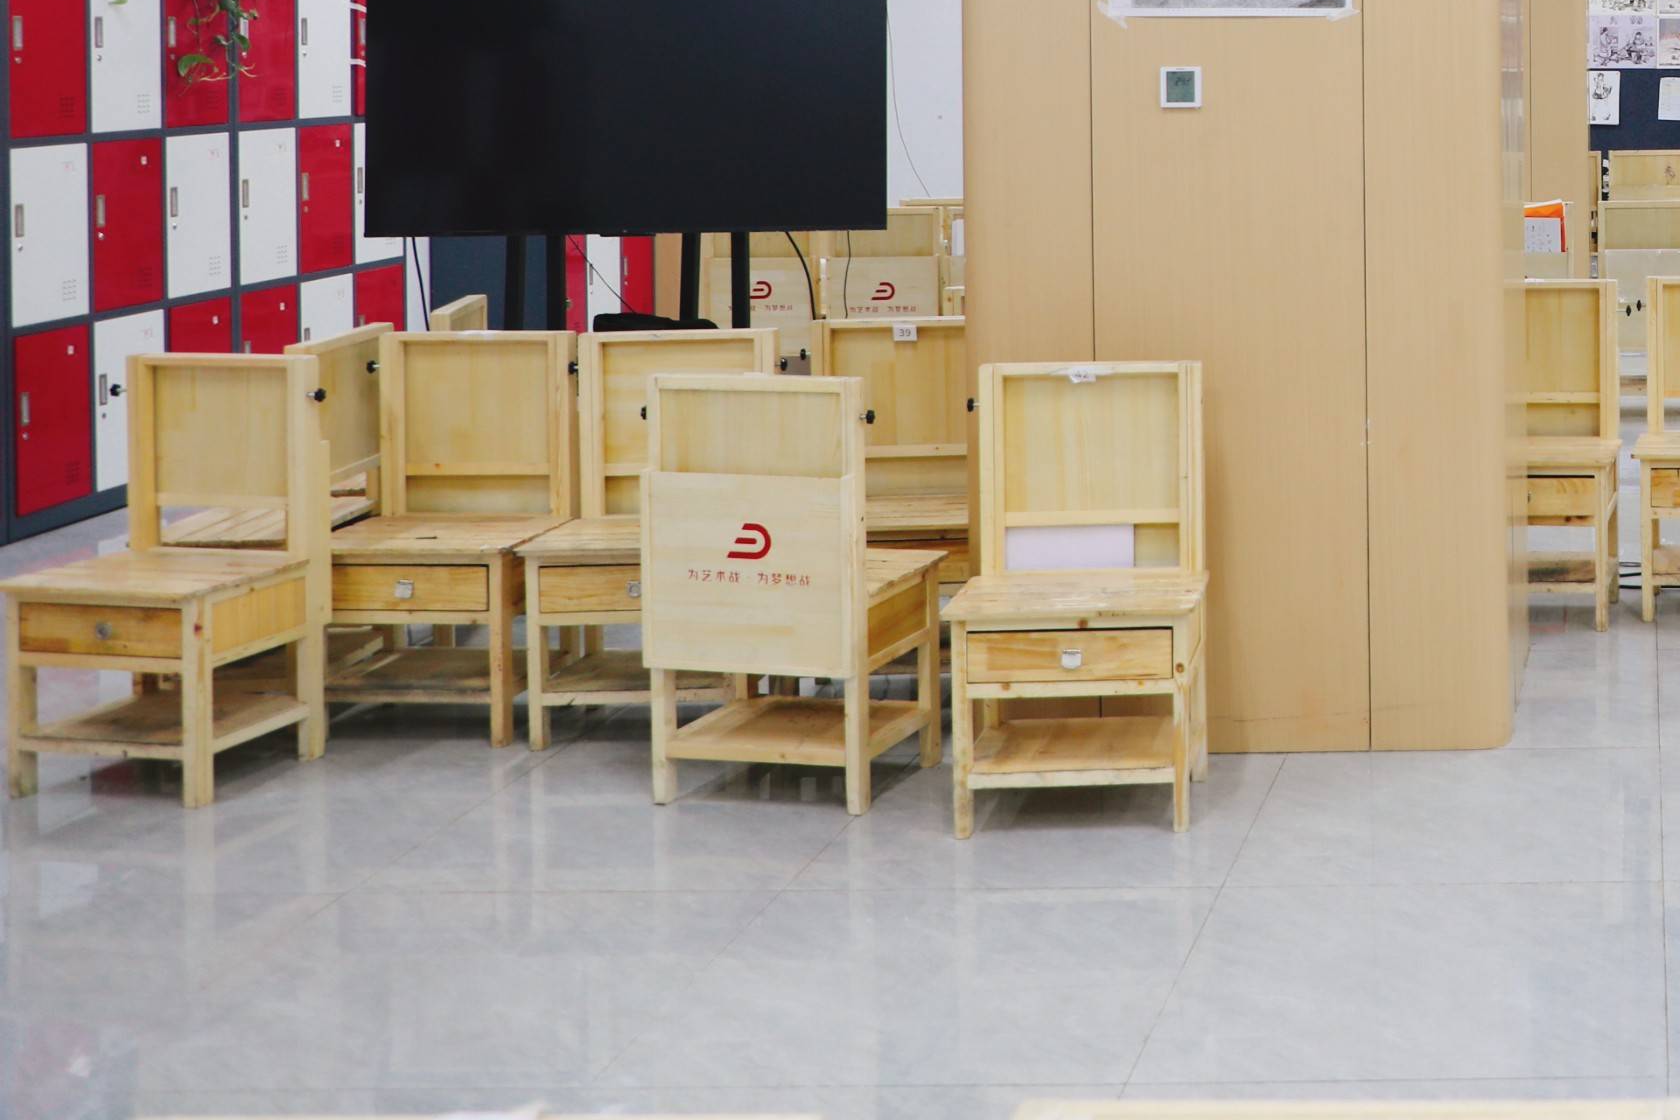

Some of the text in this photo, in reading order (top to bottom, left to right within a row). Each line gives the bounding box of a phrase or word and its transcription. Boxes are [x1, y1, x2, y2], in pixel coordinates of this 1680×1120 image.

[899, 328, 912, 337] 39
[688, 569, 812, 586] 为艺术战 为梦想战
